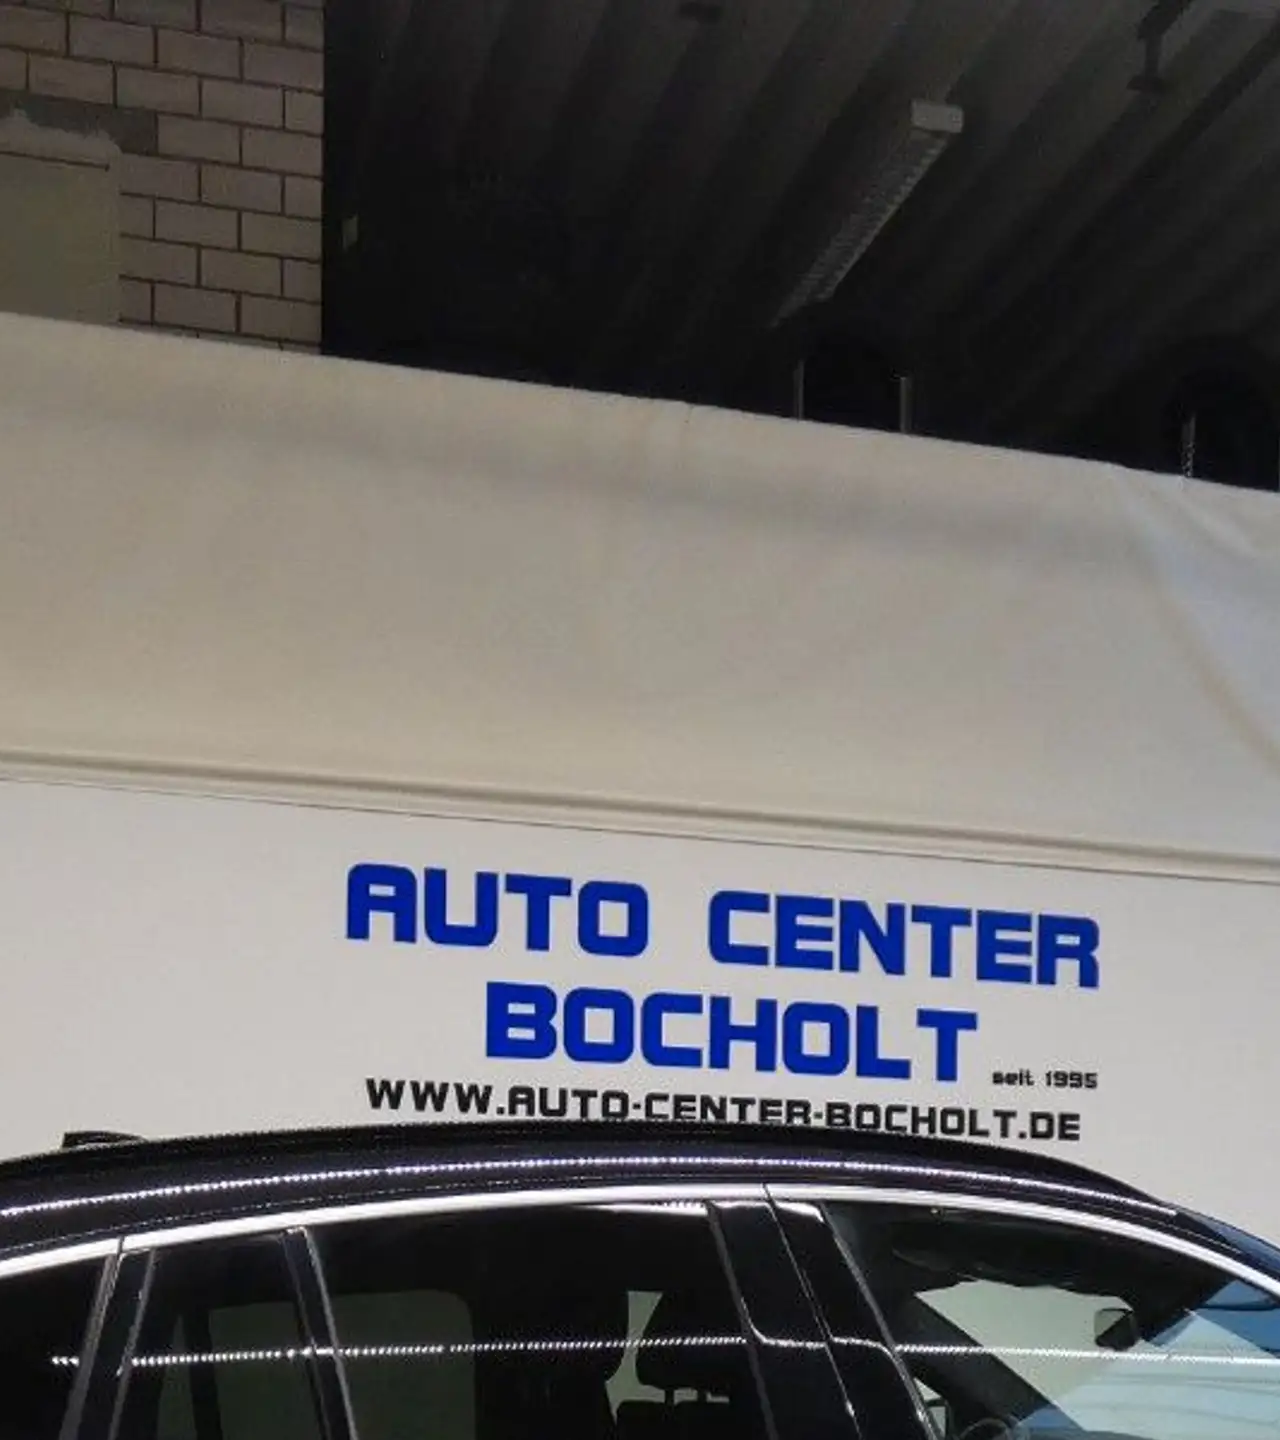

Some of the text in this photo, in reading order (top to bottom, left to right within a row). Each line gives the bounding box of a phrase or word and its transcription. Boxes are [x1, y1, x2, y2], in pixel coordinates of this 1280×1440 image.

[346, 863, 1100, 989] AUTO CENTER
[485, 980, 980, 1084] BOCHOLT
[365, 1077, 1081, 1141] WWW.AUTO-CENTER-BOCHOLT.DE
[991, 1068, 1099, 1090] seit 1995
